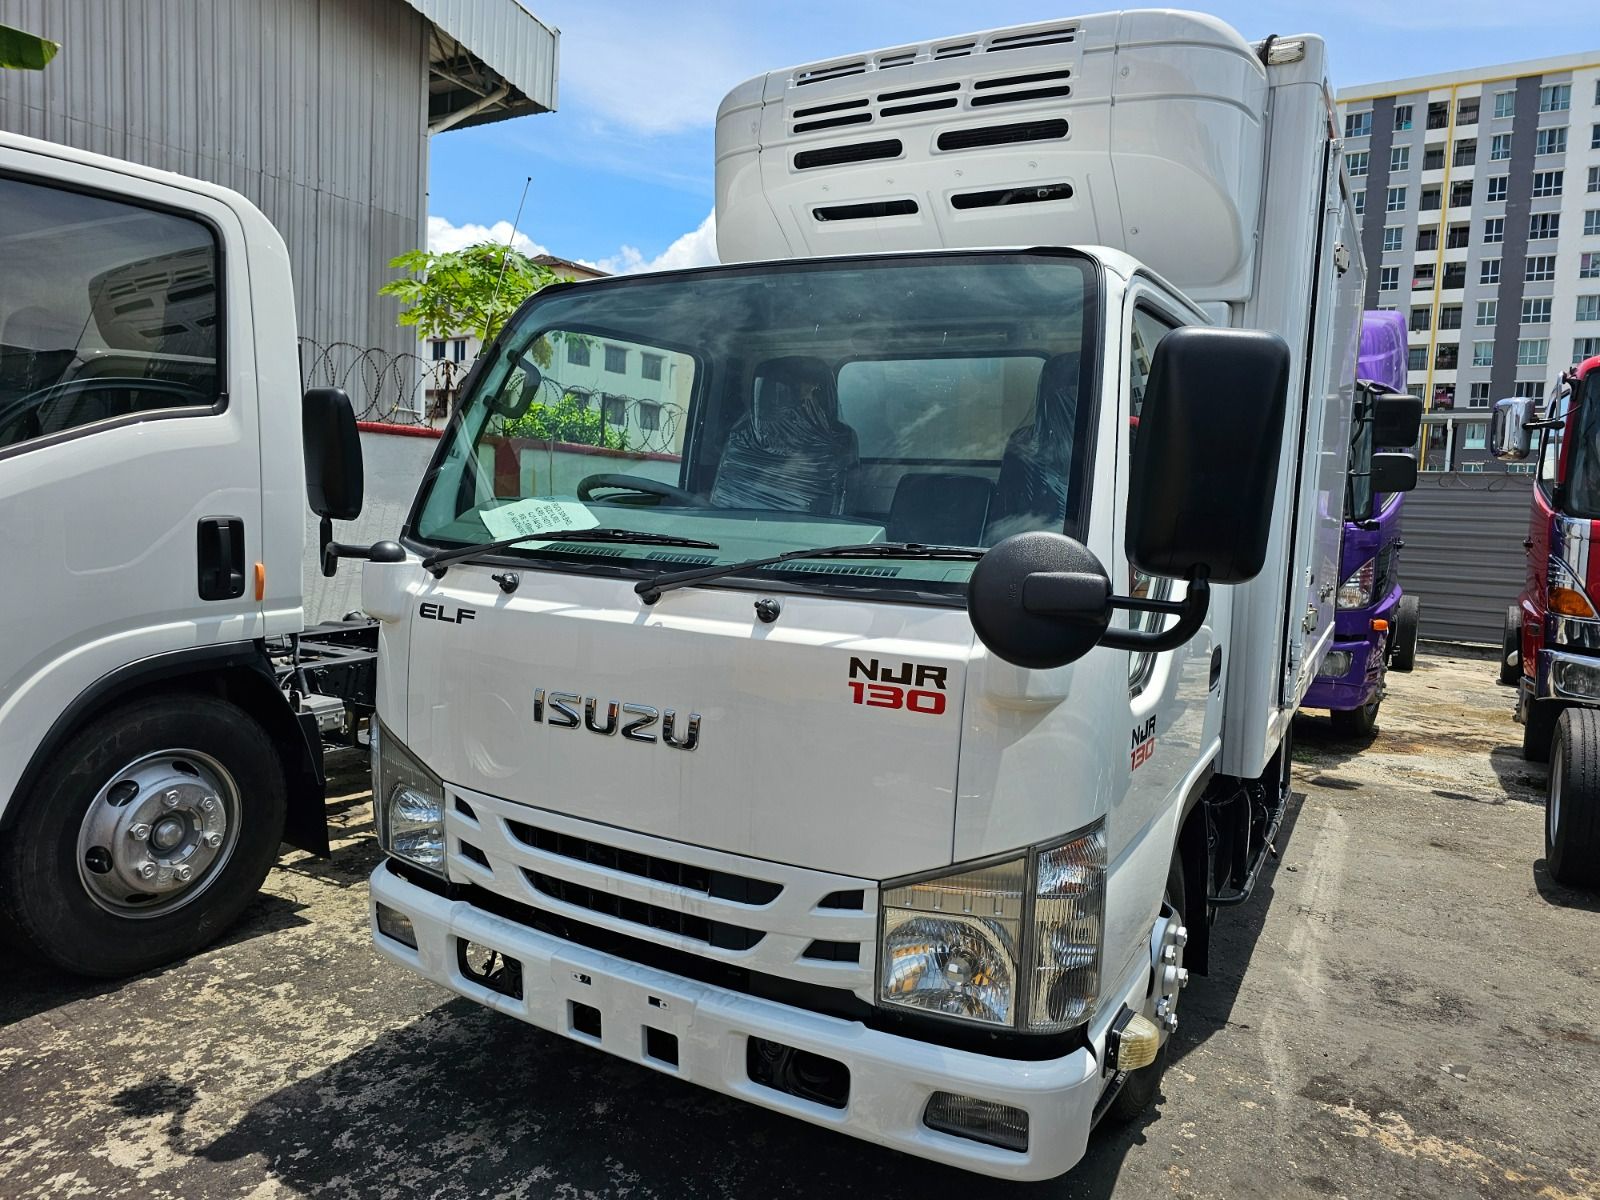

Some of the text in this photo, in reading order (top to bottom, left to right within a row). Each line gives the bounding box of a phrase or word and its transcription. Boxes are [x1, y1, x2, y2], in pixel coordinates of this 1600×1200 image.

[419, 602, 476, 624] ELF
[849, 656, 947, 689] NJR
[848, 681, 946, 715] 130
[534, 687, 701, 751] ISUZU
[1131, 714, 1156, 749] NJR
[1131, 736, 1155, 771] 130
